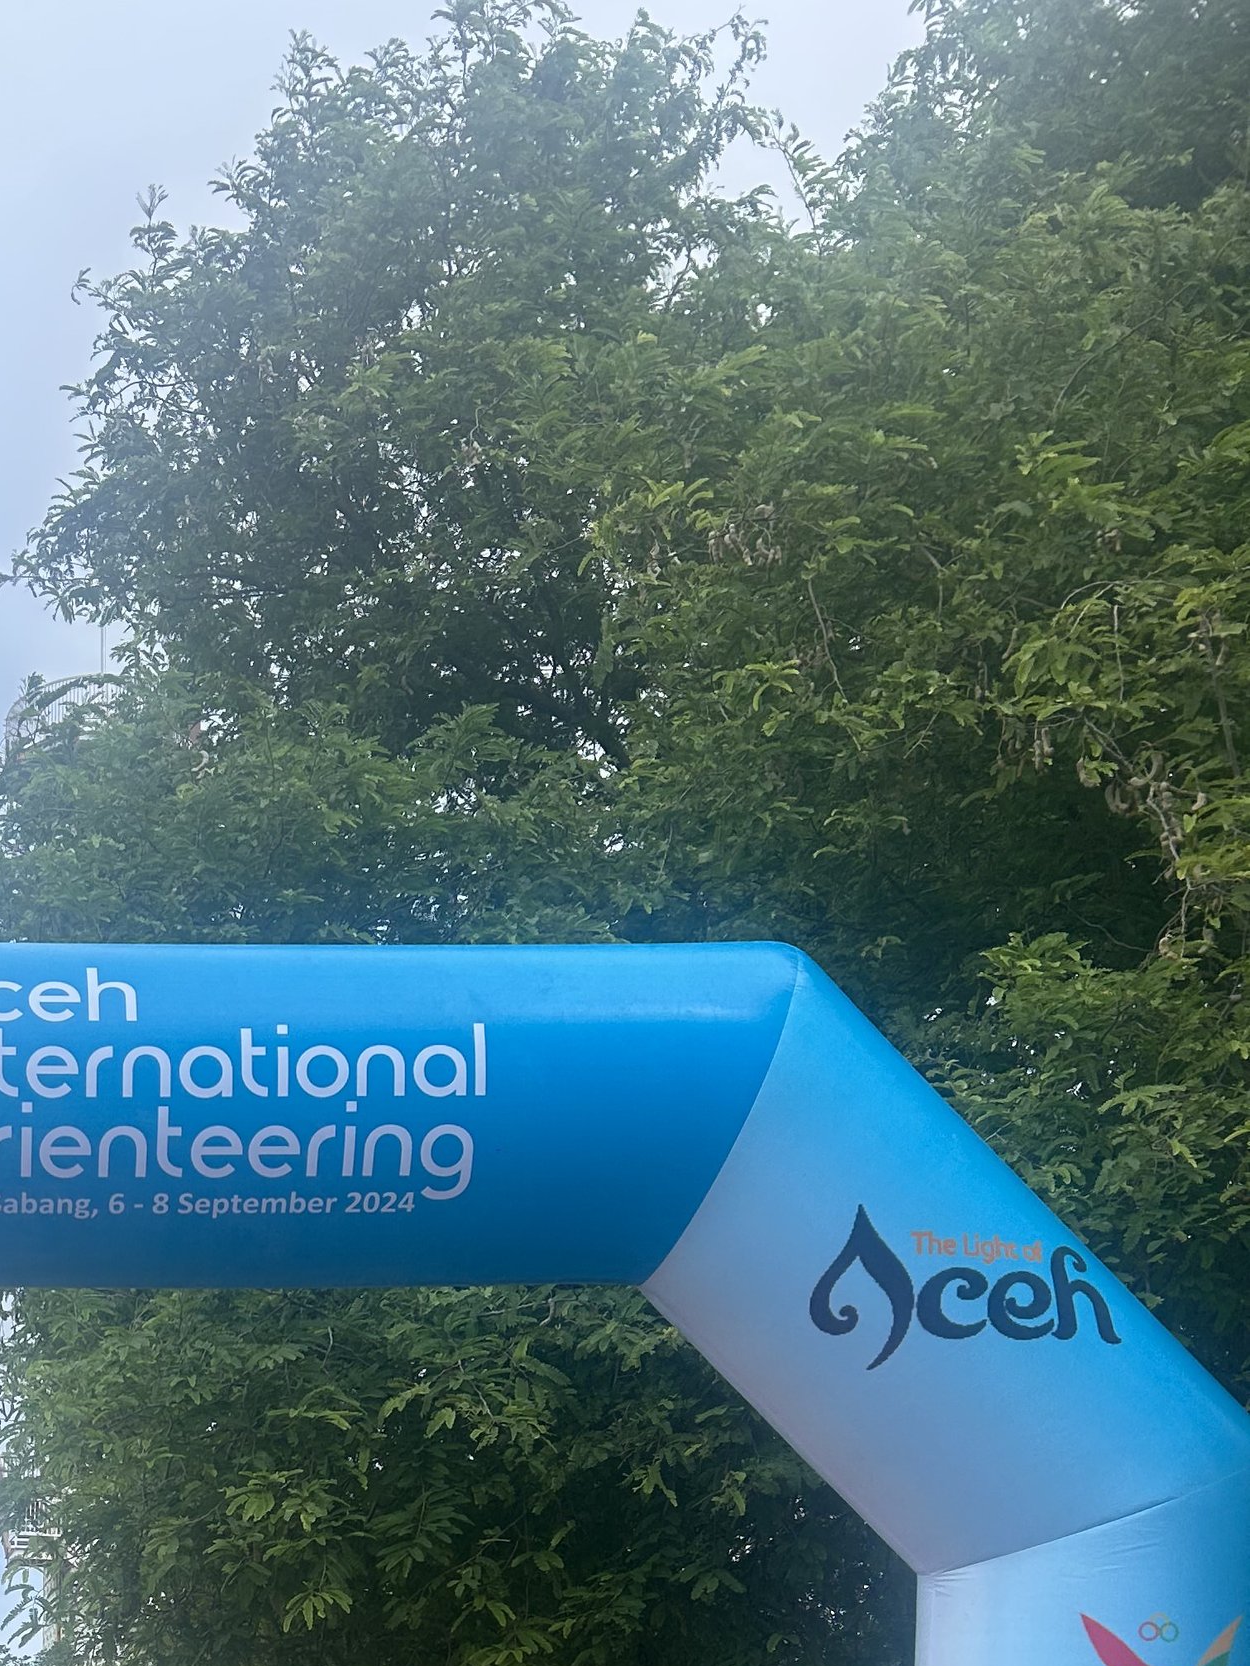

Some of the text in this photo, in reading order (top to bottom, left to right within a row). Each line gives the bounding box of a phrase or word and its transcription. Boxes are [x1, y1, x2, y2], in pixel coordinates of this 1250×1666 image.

[108, 1193, 125, 1214] 6
[152, 1193, 170, 1214] 8
[177, 1191, 338, 1219] September
[345, 1192, 416, 1213] 2024
[910, 1231, 1043, 1264] The Light of
[809, 1203, 1122, 1370] Aceh
